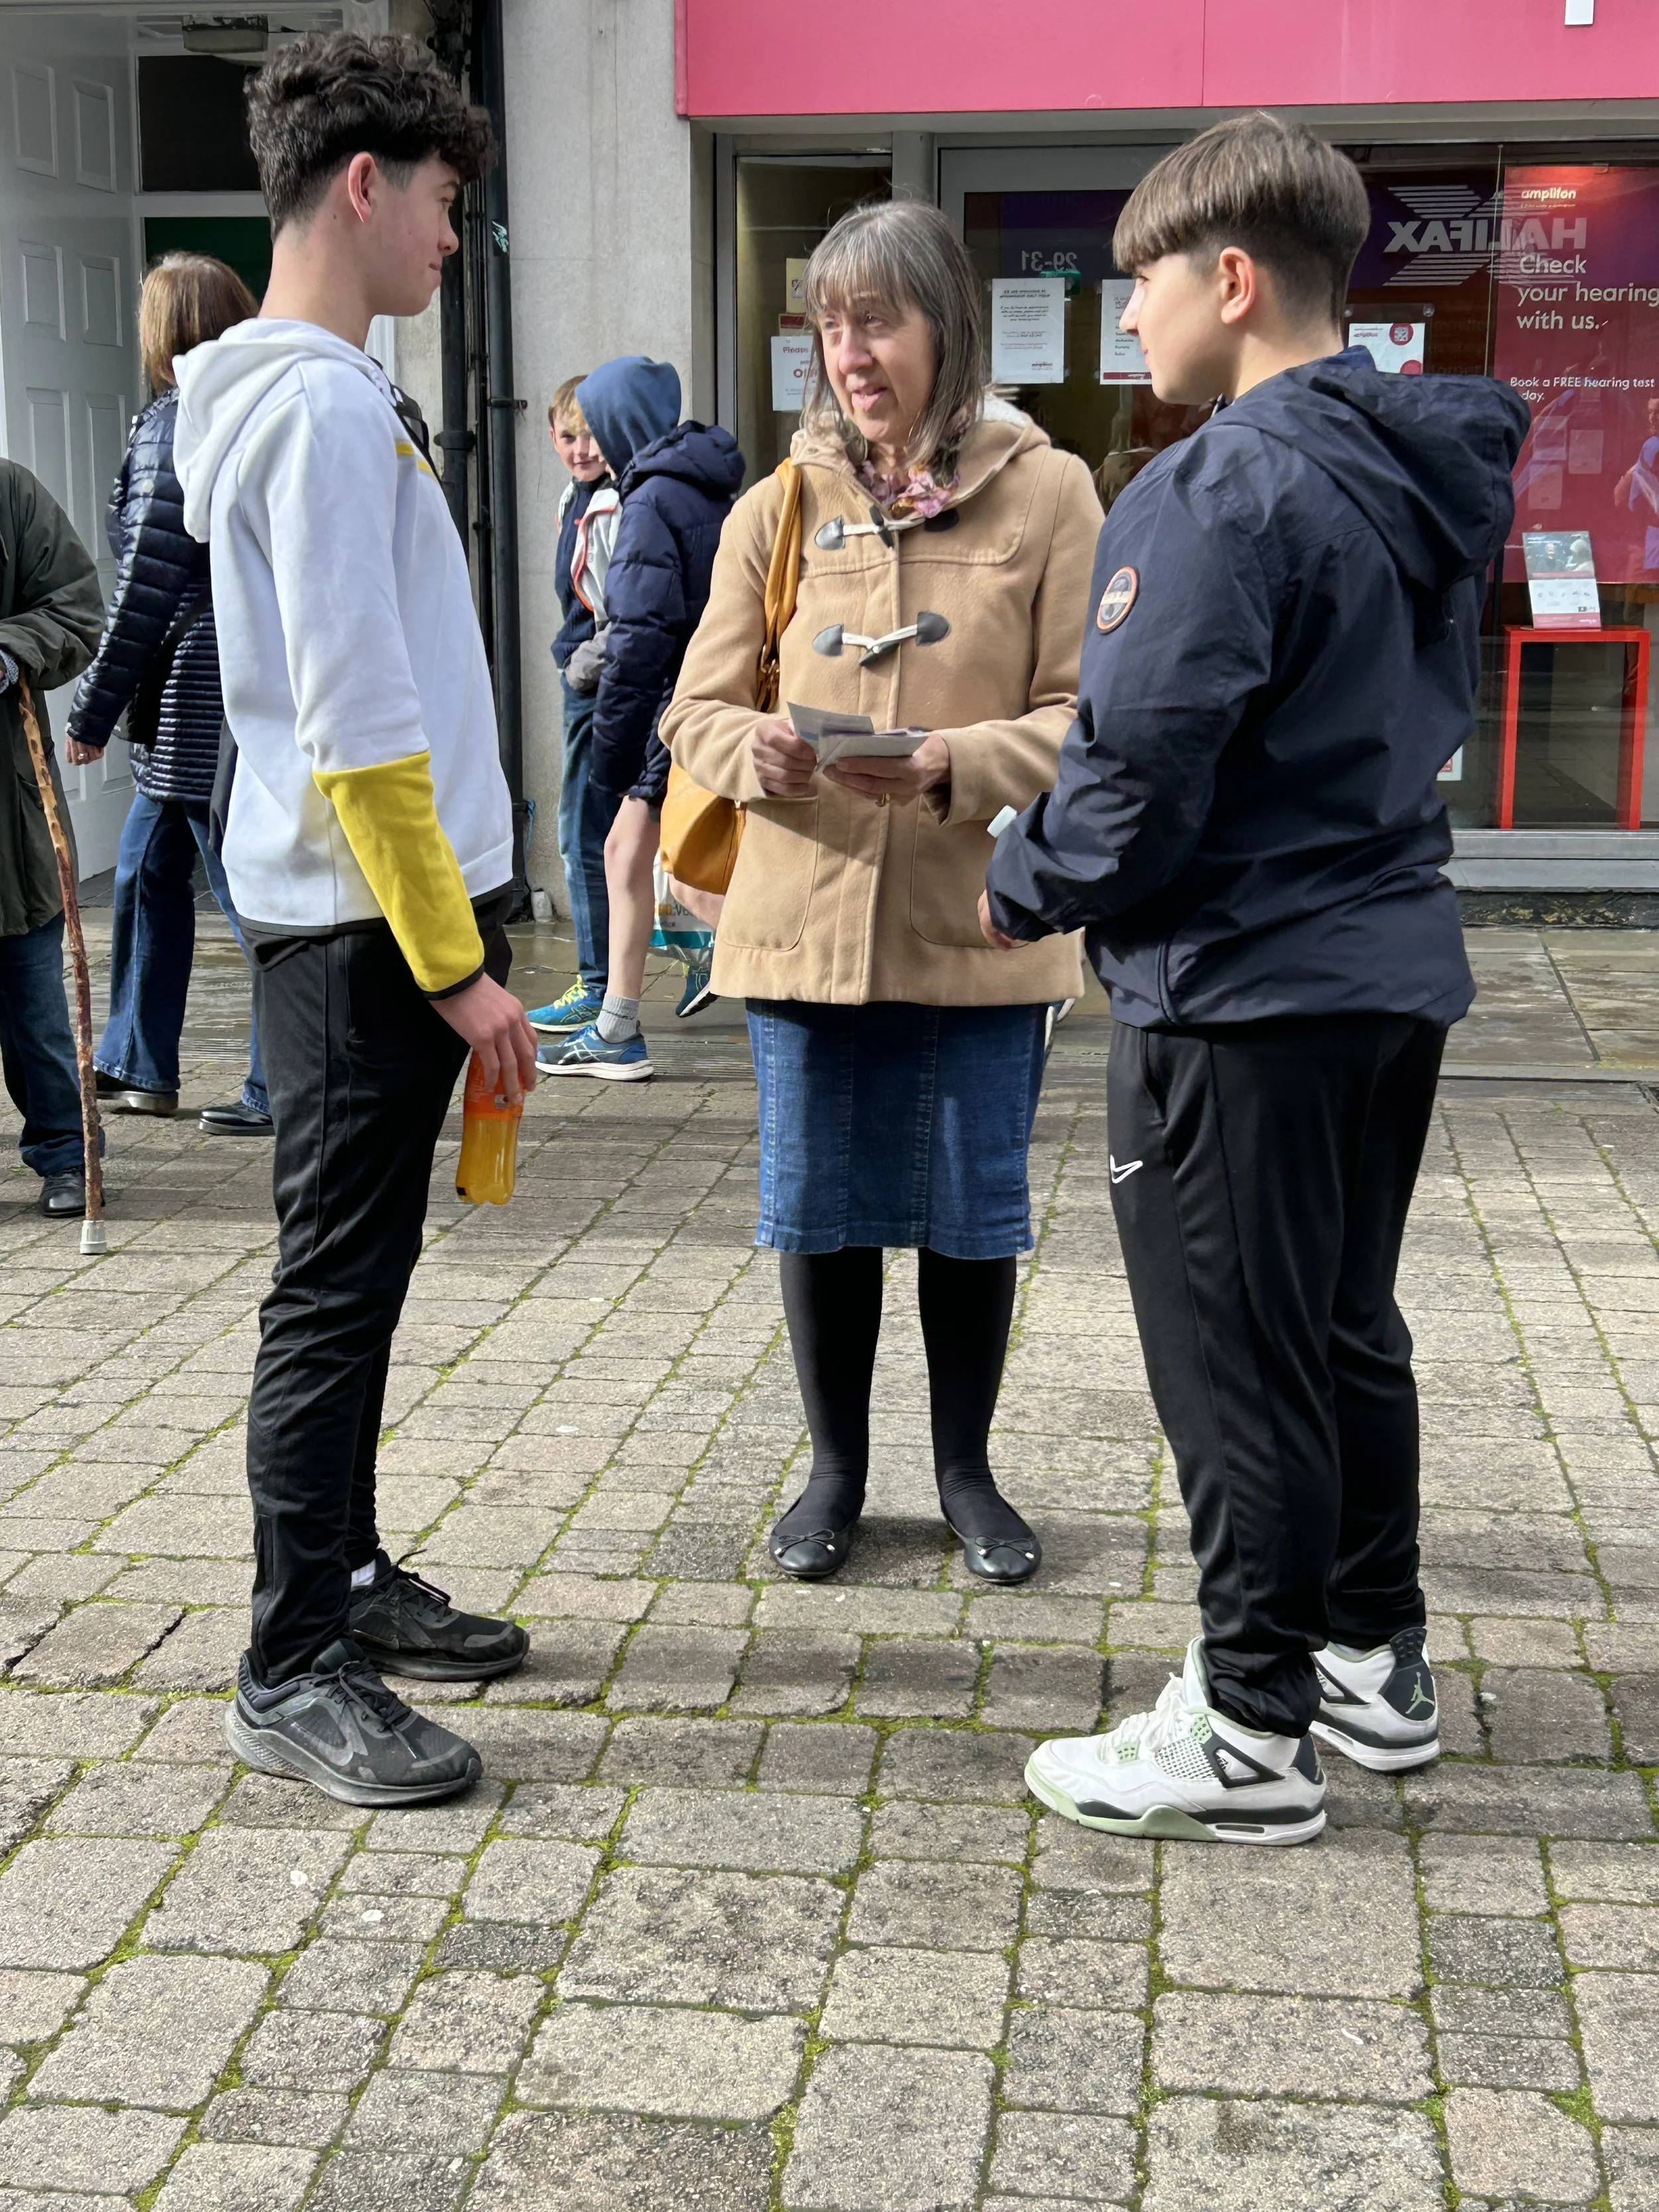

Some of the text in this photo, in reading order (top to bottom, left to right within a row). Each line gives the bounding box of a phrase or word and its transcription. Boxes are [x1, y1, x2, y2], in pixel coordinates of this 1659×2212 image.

[1520, 254, 1587, 274] Check
[1517, 282, 1659, 307] your hearing
[1516, 310, 1600, 329] with us.
[1510, 377, 1540, 387] Book
[1553, 377, 1581, 387] FREE
[1584, 377, 1630, 390] hearing
[1633, 378, 1655, 387] test
